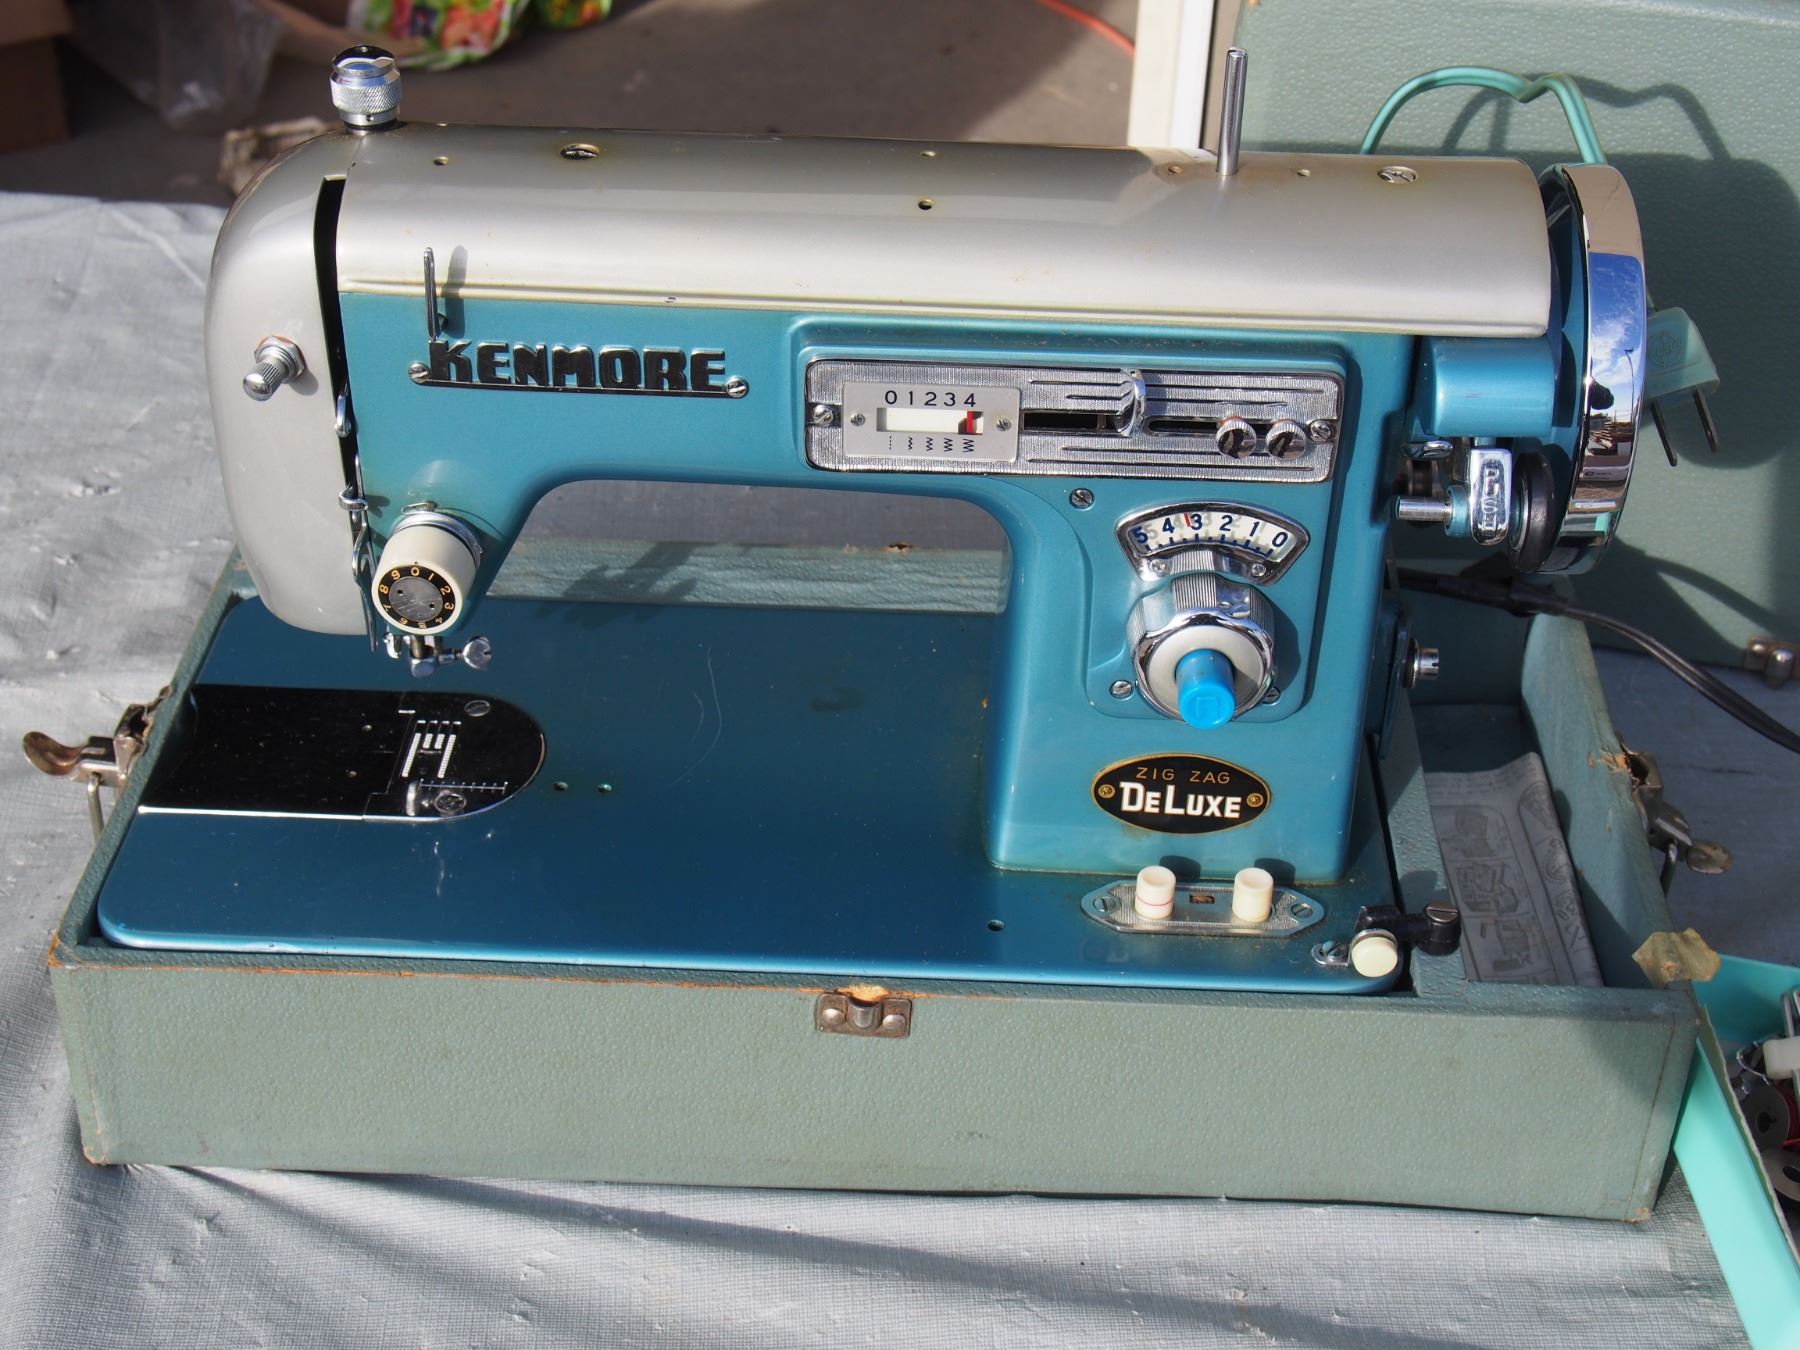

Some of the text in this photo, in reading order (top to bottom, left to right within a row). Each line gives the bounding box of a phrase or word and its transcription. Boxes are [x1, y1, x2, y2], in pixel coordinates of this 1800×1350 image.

[429, 340, 726, 391] KENMORE
[885, 390, 976, 407] 0 1 2 3 4
[1131, 514, 1288, 548] 5 4 3 2 1 0
[391, 570, 400, 580] 9
[410, 567, 420, 576] 0
[379, 584, 389, 594] 8
[440, 585, 451, 595] 2
[444, 602, 454, 610] 3
[1135, 767, 1231, 784] ZIG ZAG
